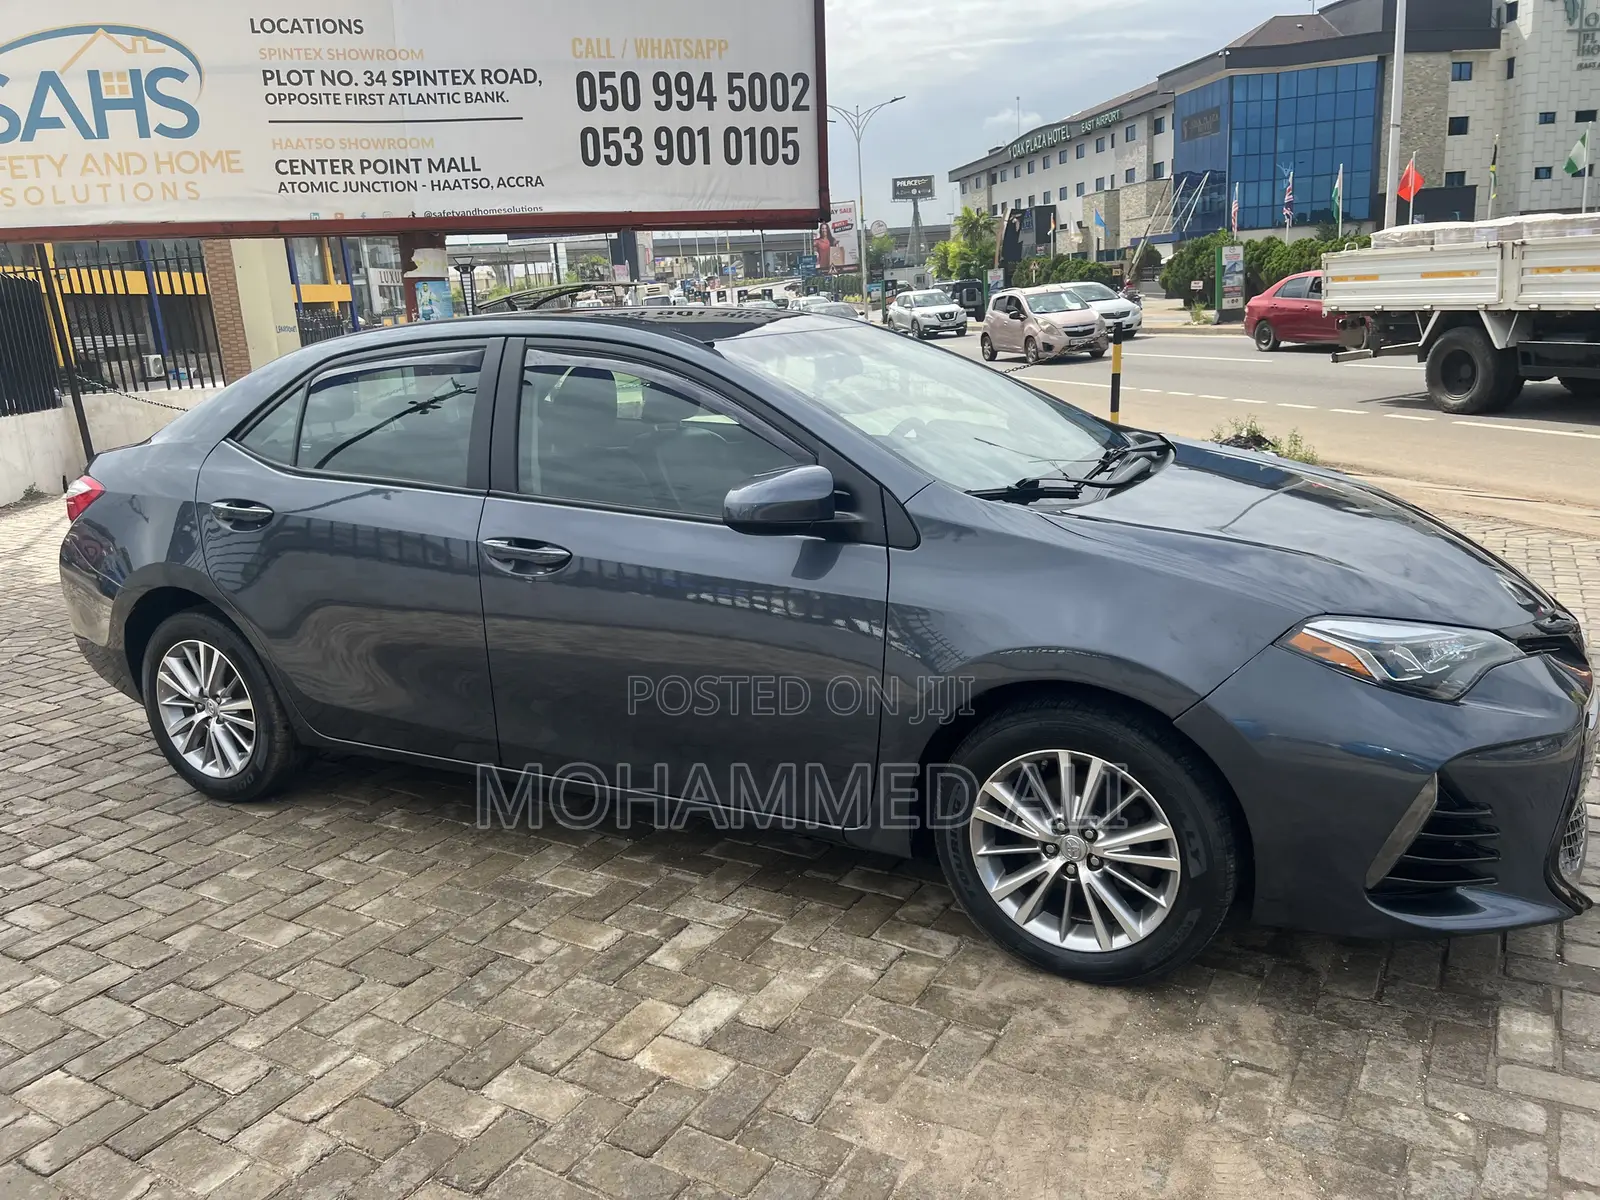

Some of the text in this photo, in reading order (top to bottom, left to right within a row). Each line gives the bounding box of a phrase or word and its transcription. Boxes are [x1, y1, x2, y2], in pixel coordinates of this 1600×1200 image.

[249, 18, 364, 35] LOCATIONS
[258, 47, 425, 62] SPINTEX SHOWROOM
[571, 37, 729, 60] CALL / WHATSAPP
[261, 67, 543, 88] PLOT NO. 34 SPINTEX ROAD,
[264, 91, 510, 106] OPPOSITE FIRST ATLANTIC BANK.
[575, 70, 810, 112] 050 994 5002
[271, 137, 435, 151] HAATSO SHOWROOM
[1012, 110, 1120, 158] OAK PLAZA HOTEL EAST AIRPORT
[579, 126, 800, 167] 053 901 0105
[79, 150, 148, 177] AND
[154, 149, 245, 175] HOME
[274, 156, 482, 176] CENTER POINT MALL
[0, 180, 201, 208] SOLUTIONS
[277, 181, 339, 194] ATOMIC
[342, 180, 418, 193] JUNCTION
[430, 178, 494, 192] HAATSO,
[496, 175, 545, 188] ACCRA
[423, 205, 544, 218] @safetyandhomesolutions
[379, 270, 403, 284] LUXU
